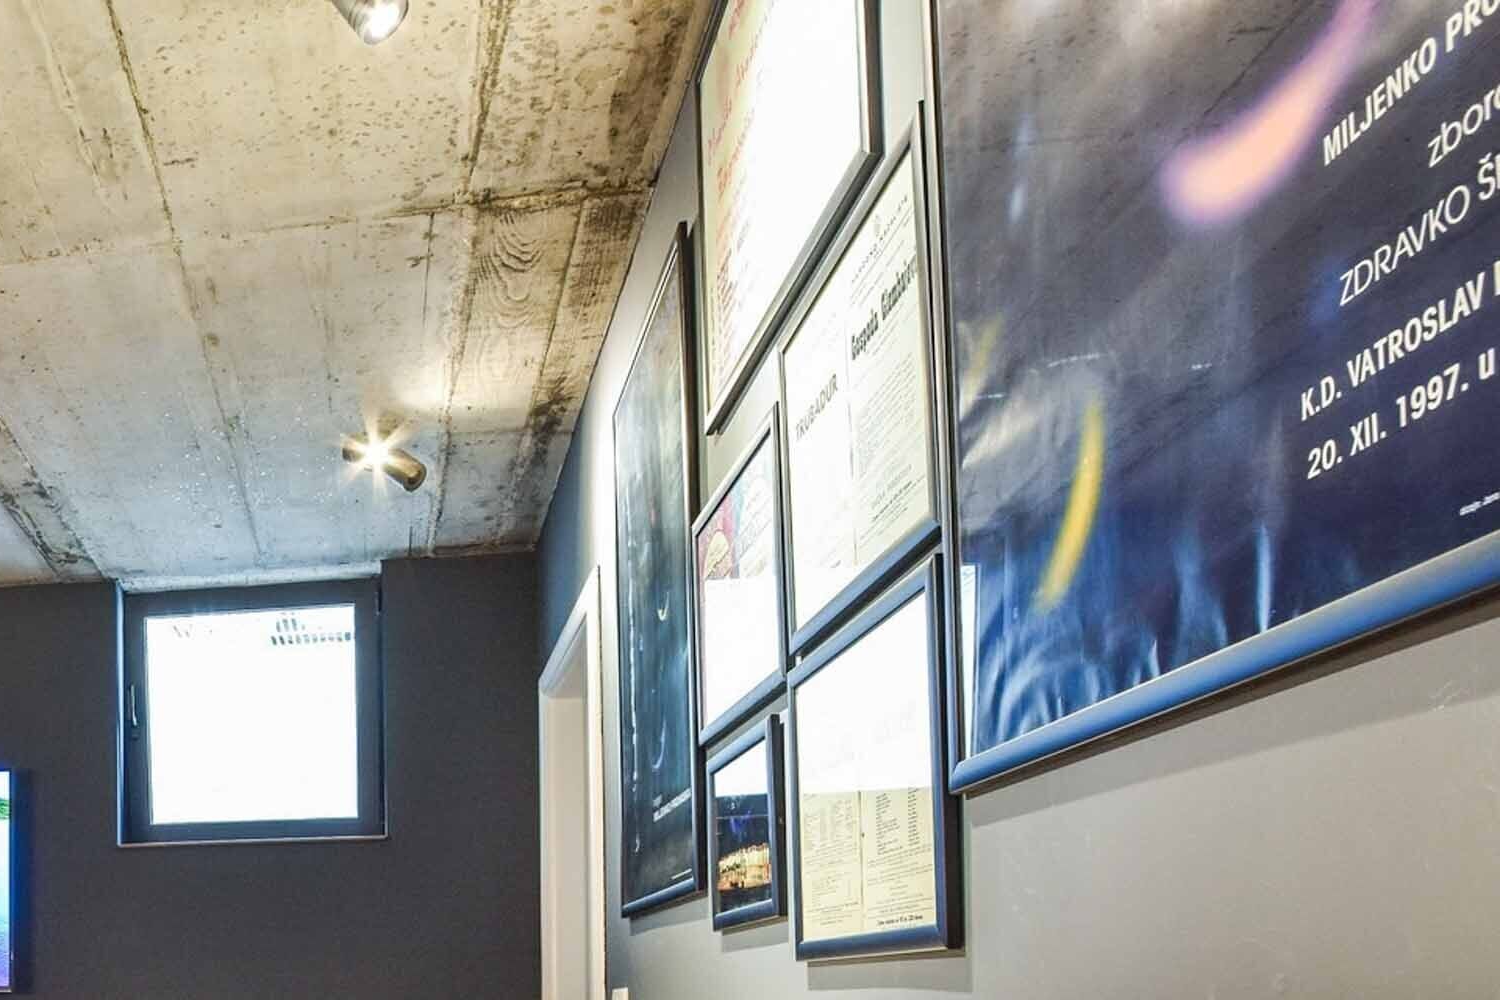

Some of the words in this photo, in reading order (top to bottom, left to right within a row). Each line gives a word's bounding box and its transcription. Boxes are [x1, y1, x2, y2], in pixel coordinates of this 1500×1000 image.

[1323, 37, 1437, 166] MILJENKO
[1340, 185, 1471, 306] ZDRAVKO
[1477, 152, 1500, 201] Š
[1301, 376, 1342, 421] K.D.
[1347, 272, 1485, 388] VATROSLAV
[1307, 439, 1343, 480] 20.
[1350, 412, 1386, 457] XII.
[1396, 363, 1469, 428] 1997.
[1478, 348, 1495, 380] u
